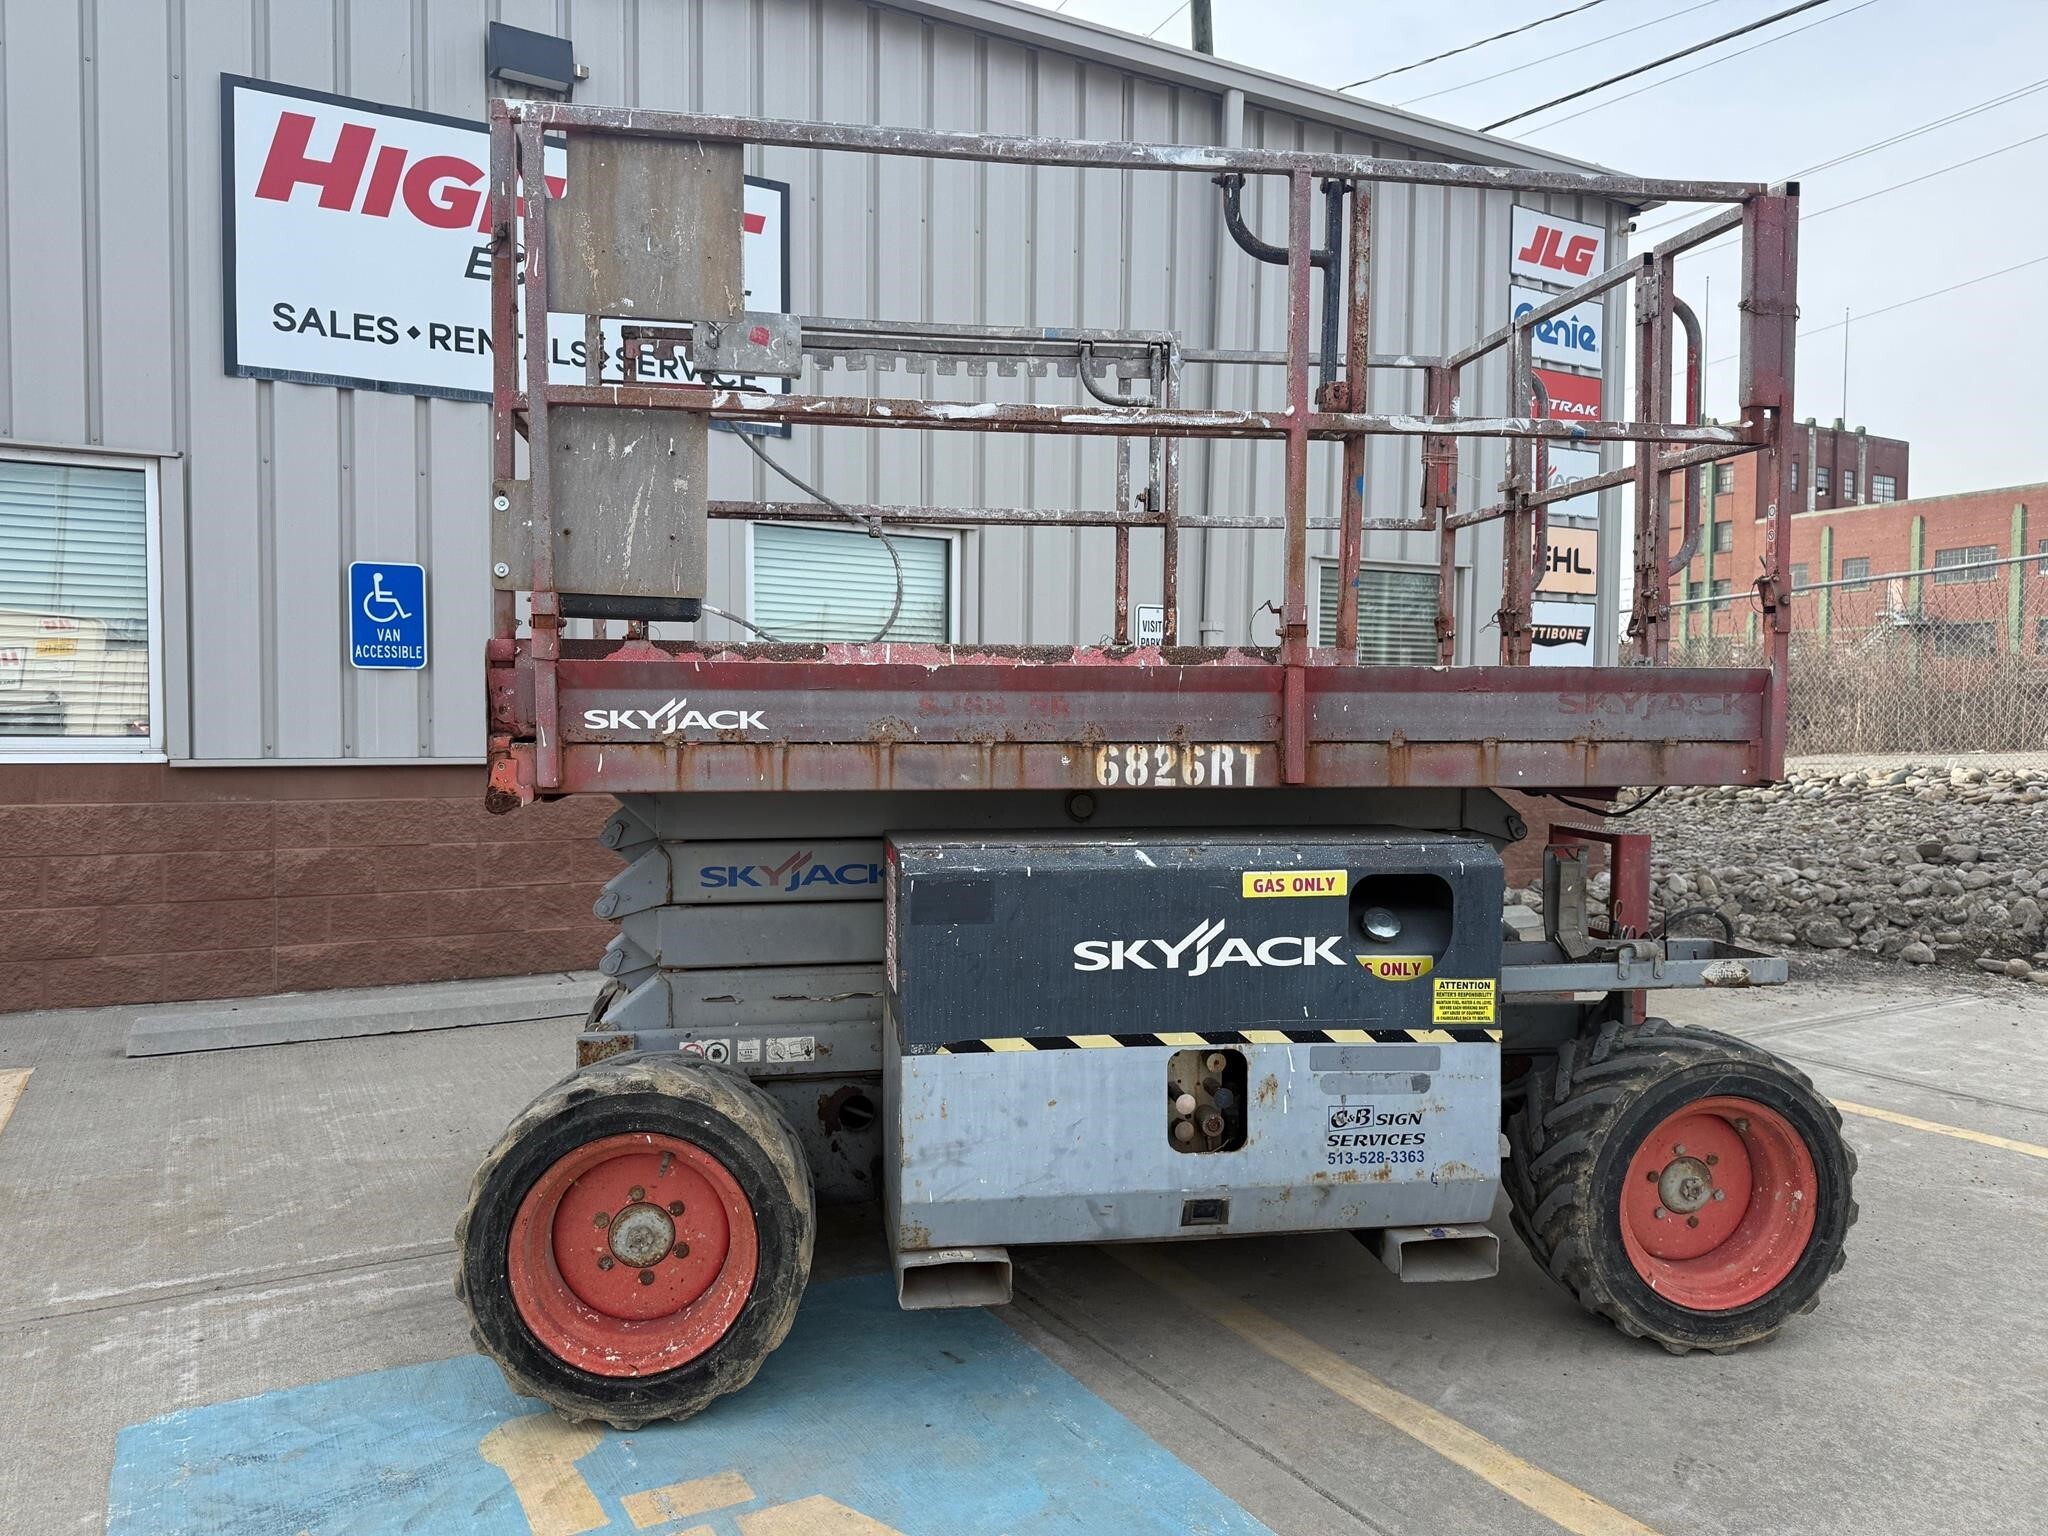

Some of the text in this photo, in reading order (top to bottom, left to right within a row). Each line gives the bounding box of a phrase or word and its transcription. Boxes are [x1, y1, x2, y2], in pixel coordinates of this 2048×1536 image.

[1518, 225, 1599, 276] JLG
[272, 302, 399, 345] SALES
[429, 322, 586, 367] RENLS
[1548, 399, 1598, 416] TRAK
[1142, 620, 1162, 632] VISIT
[1531, 626, 1583, 640] TTIBONE
[377, 628, 401, 641] VAN
[355, 644, 422, 659] ACCESSIBLE
[583, 697, 769, 734] SKYJACK
[1096, 744, 1261, 786] 6826RT
[1253, 876, 1336, 893] GAS ONLY
[1073, 918, 1347, 976] SKYJACK
[1380, 962, 1422, 976] ONLY
[1439, 981, 1491, 990] ATTENTION
[1376, 1112, 1422, 1126] SIGN
[1327, 1133, 1426, 1147] SERVICES
[1327, 1150, 1425, 1165] 513-528-3363
